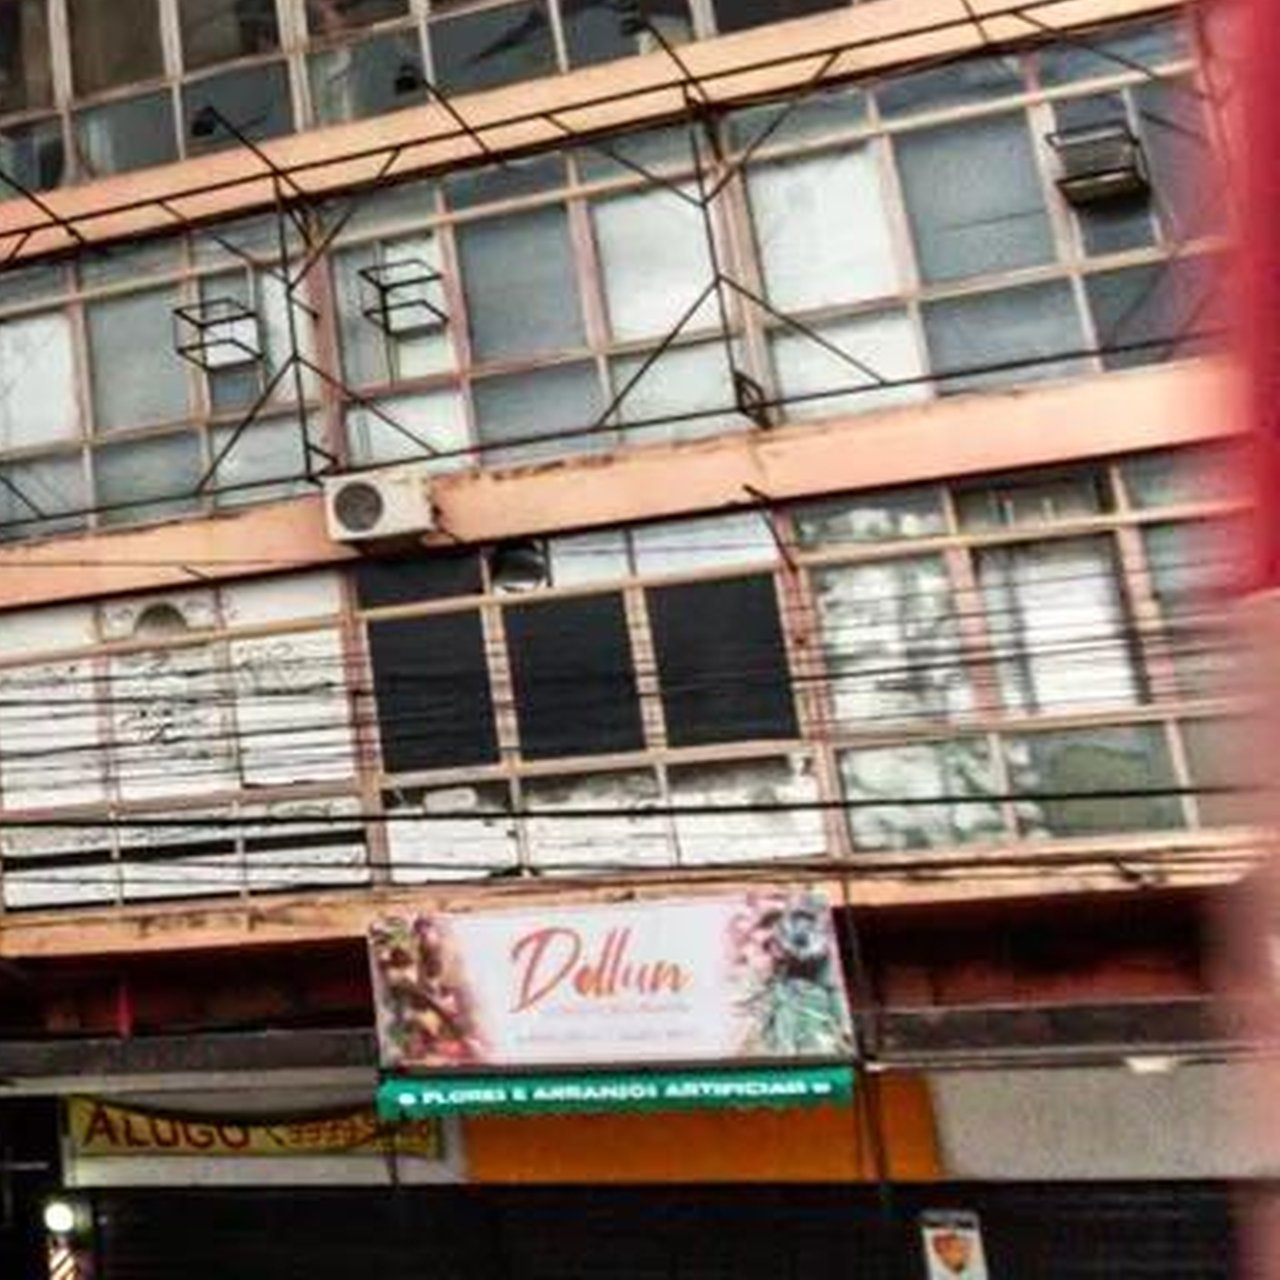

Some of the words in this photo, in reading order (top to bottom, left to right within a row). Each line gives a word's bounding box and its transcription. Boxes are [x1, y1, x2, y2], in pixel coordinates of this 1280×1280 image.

[512, 1087, 527, 1101] E
[665, 1079, 807, 1098] ARTIFICIAIS
[80, 1104, 250, 1149] ALUGO
